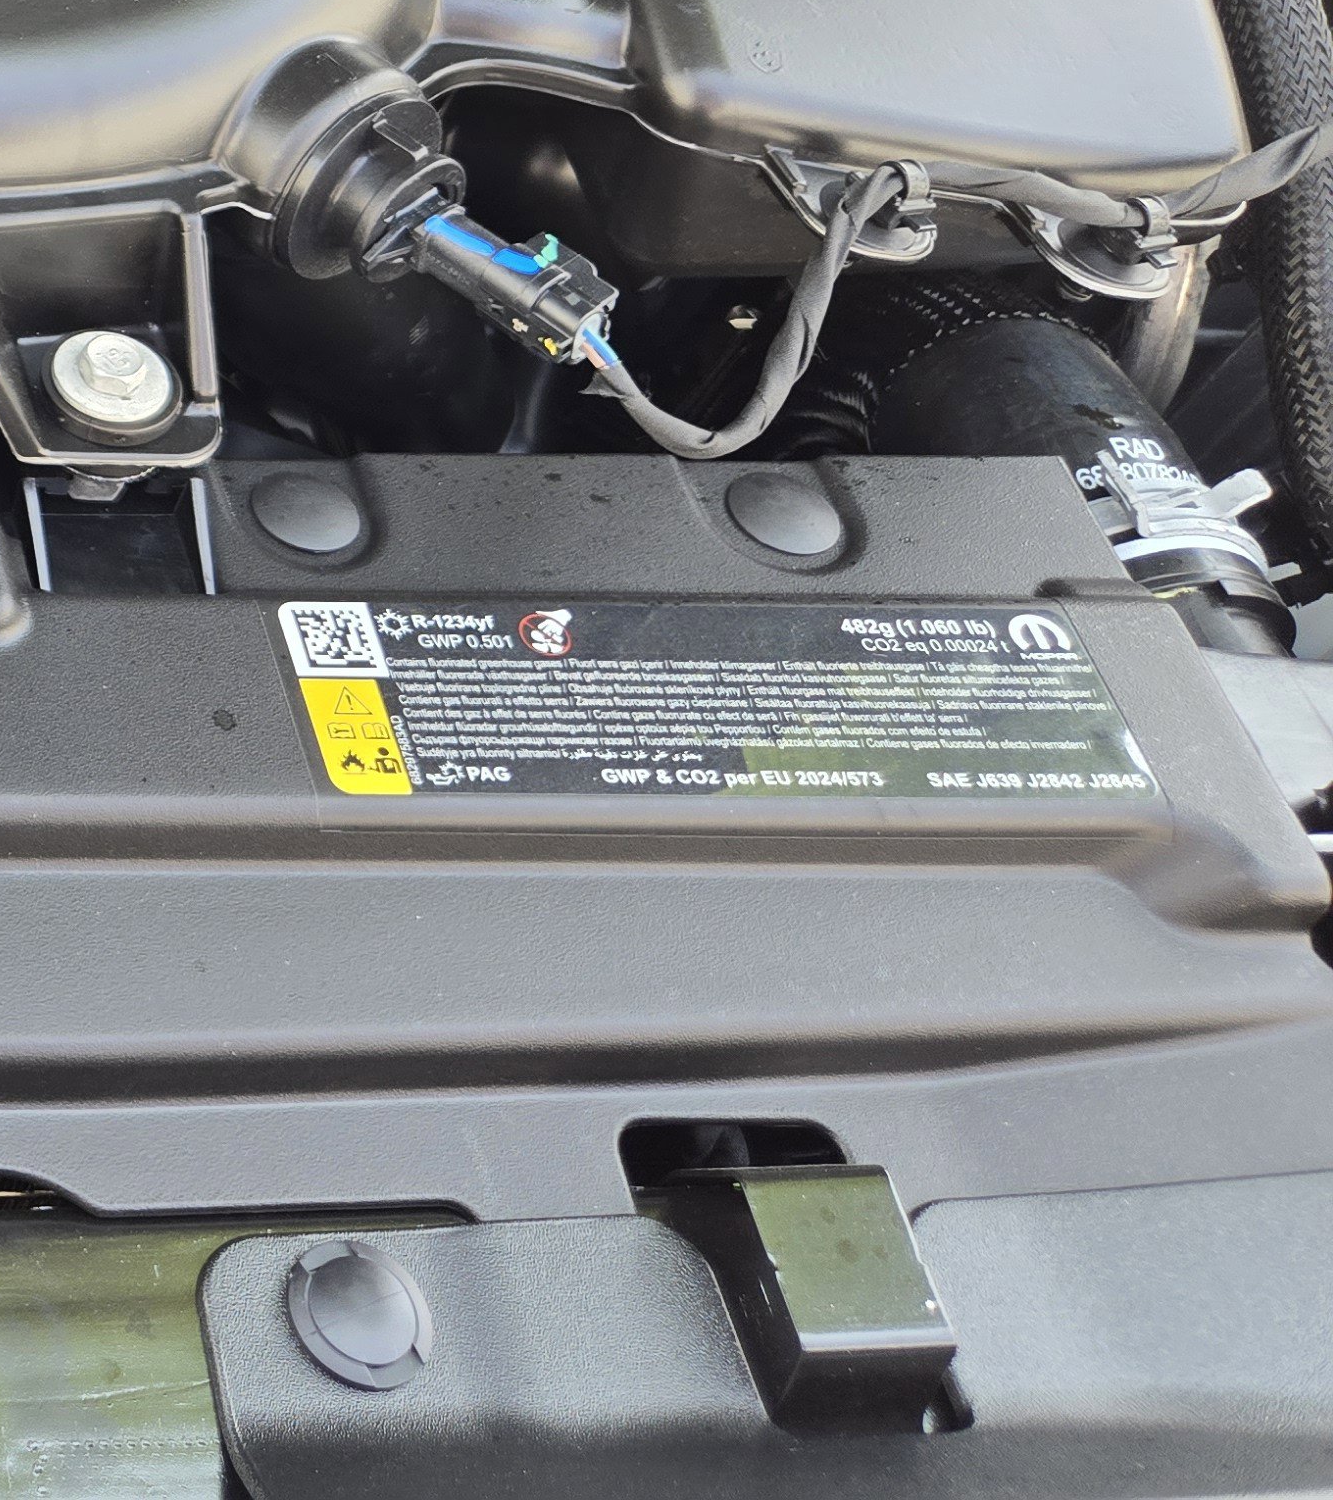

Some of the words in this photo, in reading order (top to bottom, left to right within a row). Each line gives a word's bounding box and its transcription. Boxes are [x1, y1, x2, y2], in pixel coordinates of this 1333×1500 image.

[1108, 436, 1165, 461] RAD
[410, 614, 495, 632] R-1234yf
[840, 618, 897, 638] 482g
[897, 618, 962, 638] (1.060
[965, 619, 996, 638] lb)
[417, 634, 464, 649] GWP
[466, 634, 515, 649] 0.501
[860, 638, 902, 652] CO2
[905, 641, 929, 655] eq
[929, 639, 998, 653] 0.00024
[465, 766, 511, 782] PAG
[601, 769, 651, 784] GWP
[655, 769, 673, 784] &
[675, 769, 721, 784] CO2
[723, 772, 758, 788] per
[760, 771, 790, 785] EU
[794, 771, 884, 786] 2024/573
[926, 772, 970, 788] SAE
[976, 773, 1022, 789] J639
[1027, 773, 1084, 789] J2842
[1089, 773, 1146, 789] J2845
